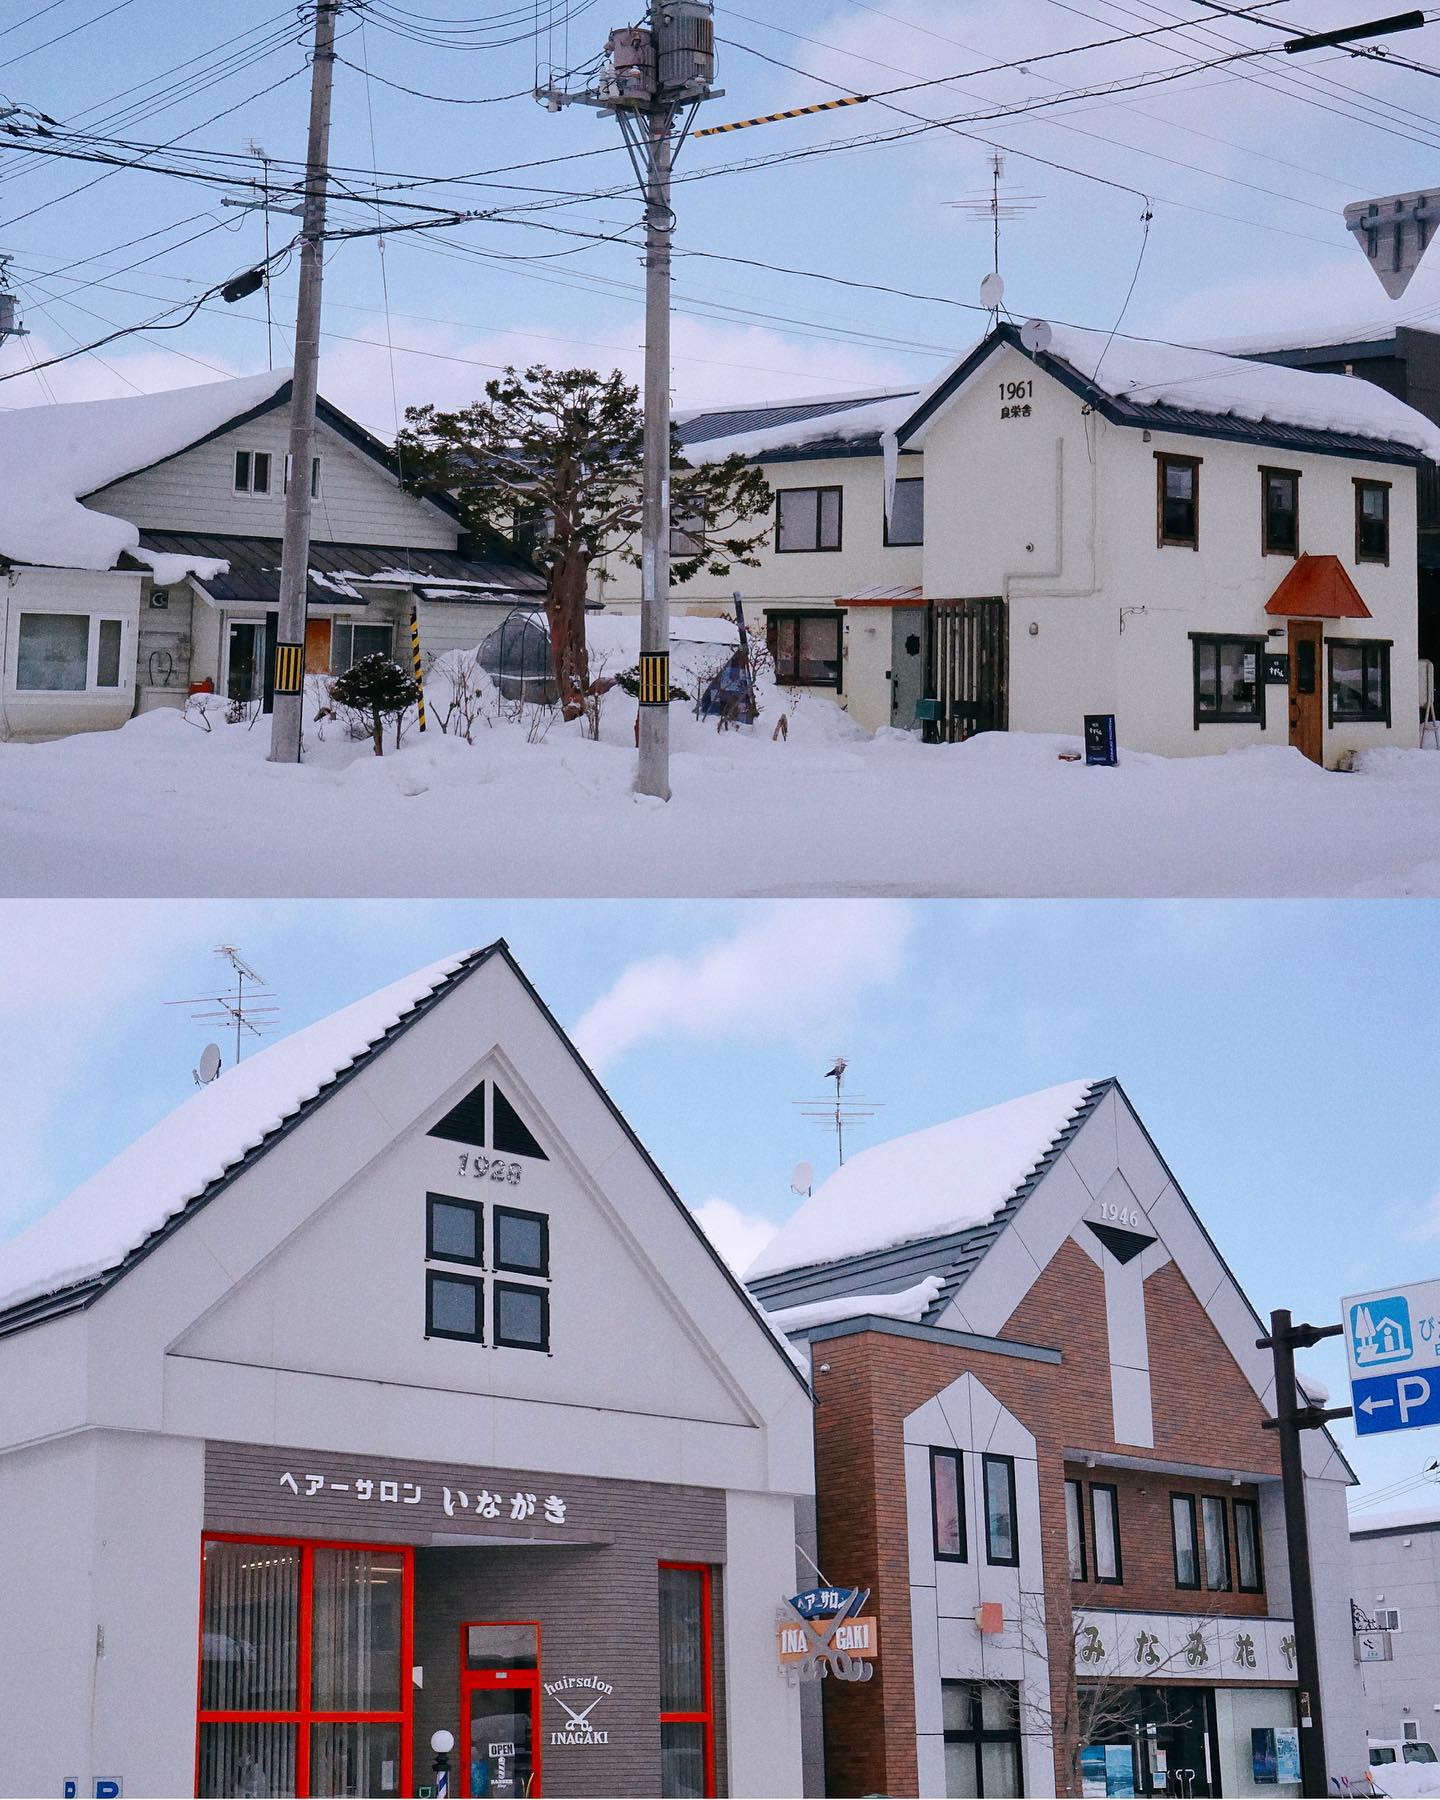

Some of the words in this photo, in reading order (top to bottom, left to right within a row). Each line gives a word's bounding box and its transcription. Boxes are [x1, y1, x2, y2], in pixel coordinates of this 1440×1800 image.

[999, 380, 1033, 400] 1961
[459, 1153, 522, 1185] 1928
[1101, 1202, 1138, 1227] 1946
[1419, 1316, 1440, 1341] び
[1397, 1376, 1430, 1423] P
[280, 1472, 421, 1504] ヘアーサロン
[443, 1486, 567, 1524] いながき
[491, 1743, 513, 1755] OPEN
[551, 1731, 609, 1745] INAGAKI
